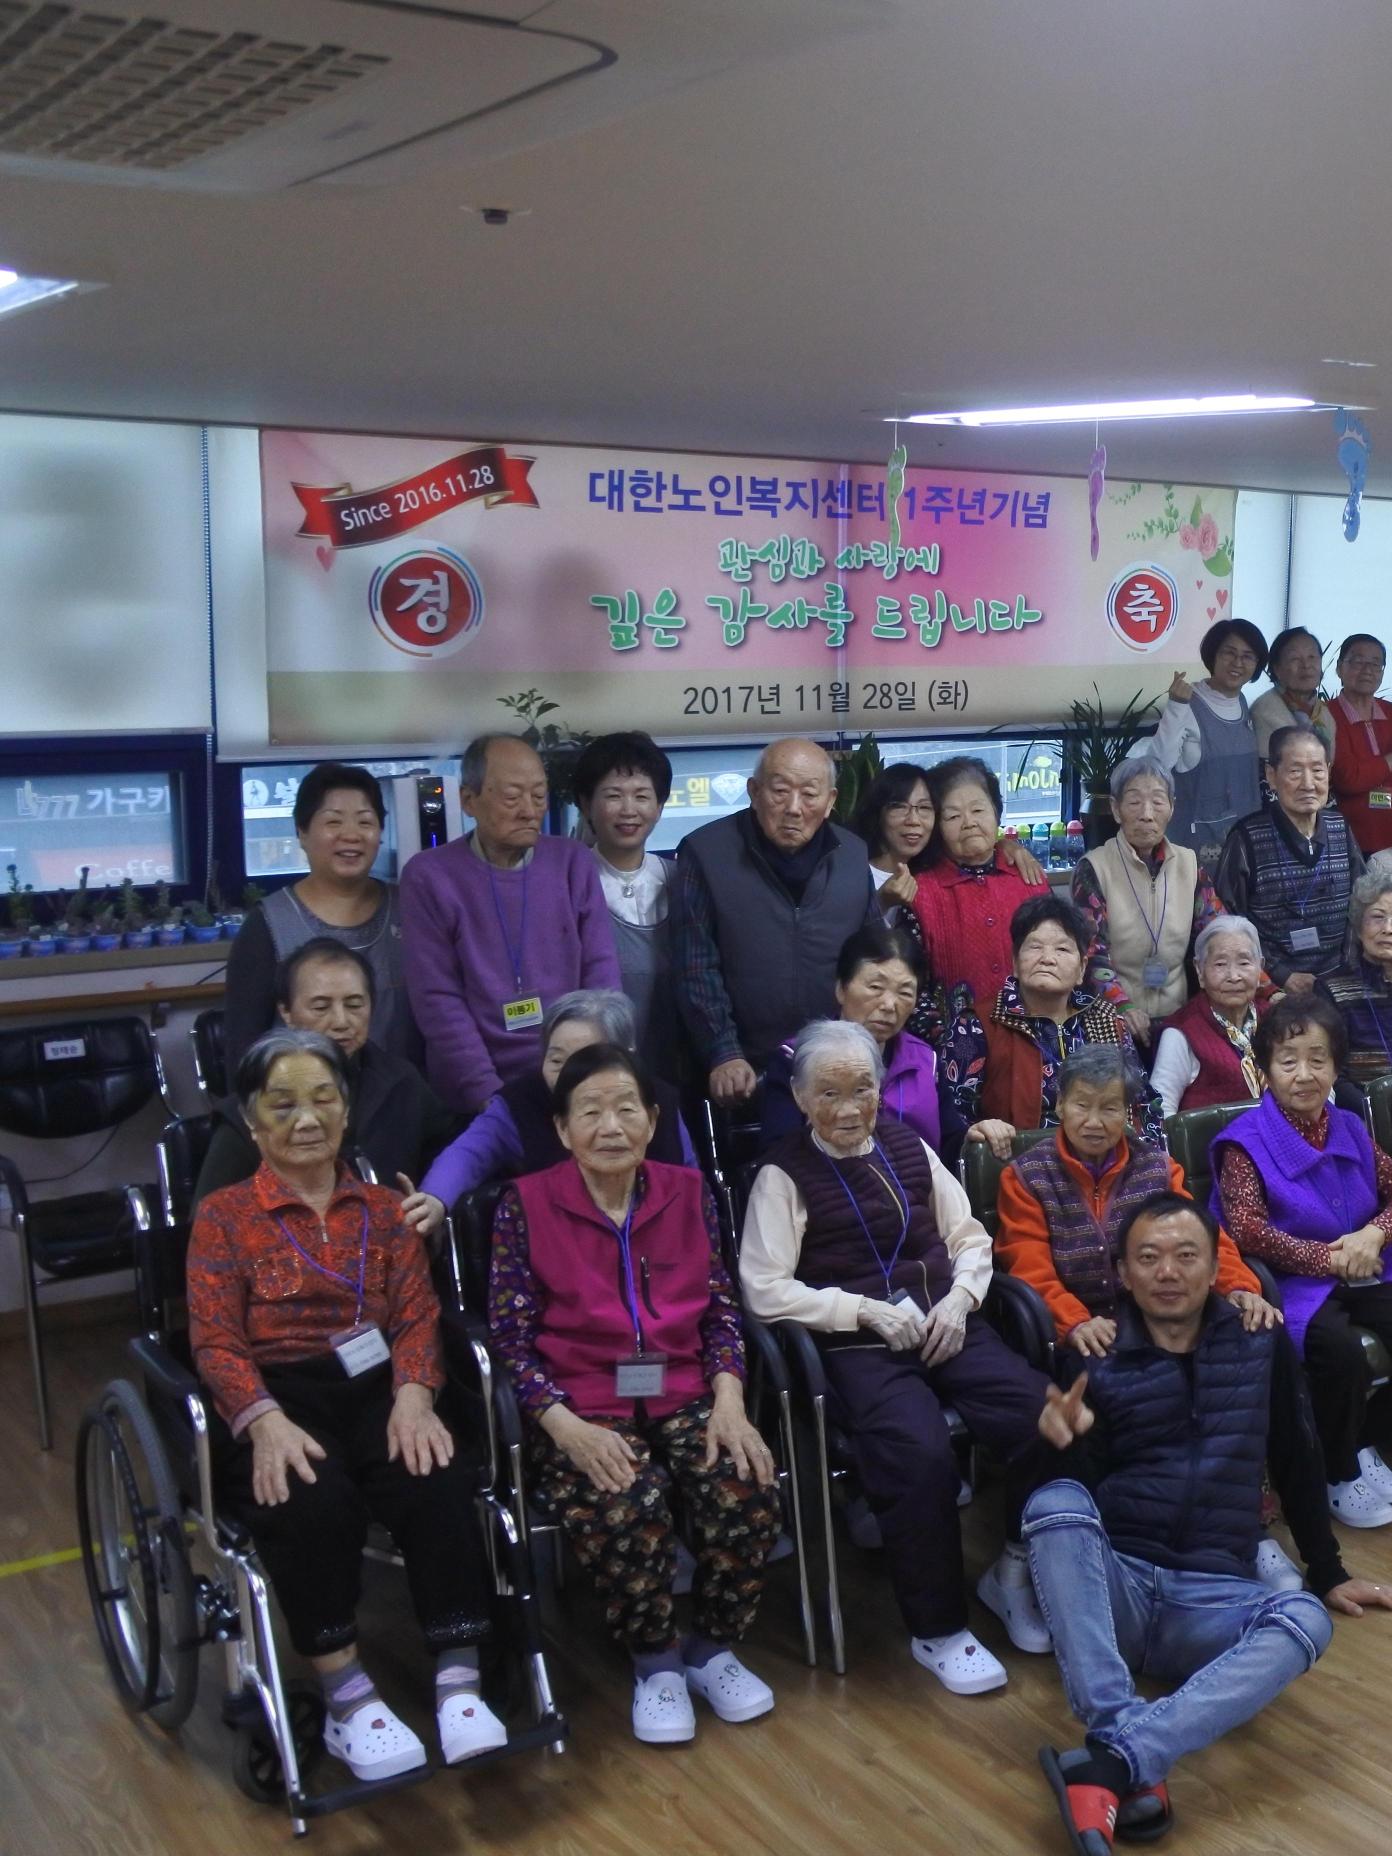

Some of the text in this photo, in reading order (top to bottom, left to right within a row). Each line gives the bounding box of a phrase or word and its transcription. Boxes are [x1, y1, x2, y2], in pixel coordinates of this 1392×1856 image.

[340, 465, 496, 532] Since 2016.11.28
[588, 468, 1051, 529] 대한노인복지센터 1주년기념
[717, 534, 941, 582] 관심과 사랑에
[396, 570, 452, 635] 경
[589, 581, 1043, 651] 깊은 감사를 드립니다
[1122, 582, 1165, 634] 축
[682, 678, 970, 716] 2017년 11월 28일 (화)
